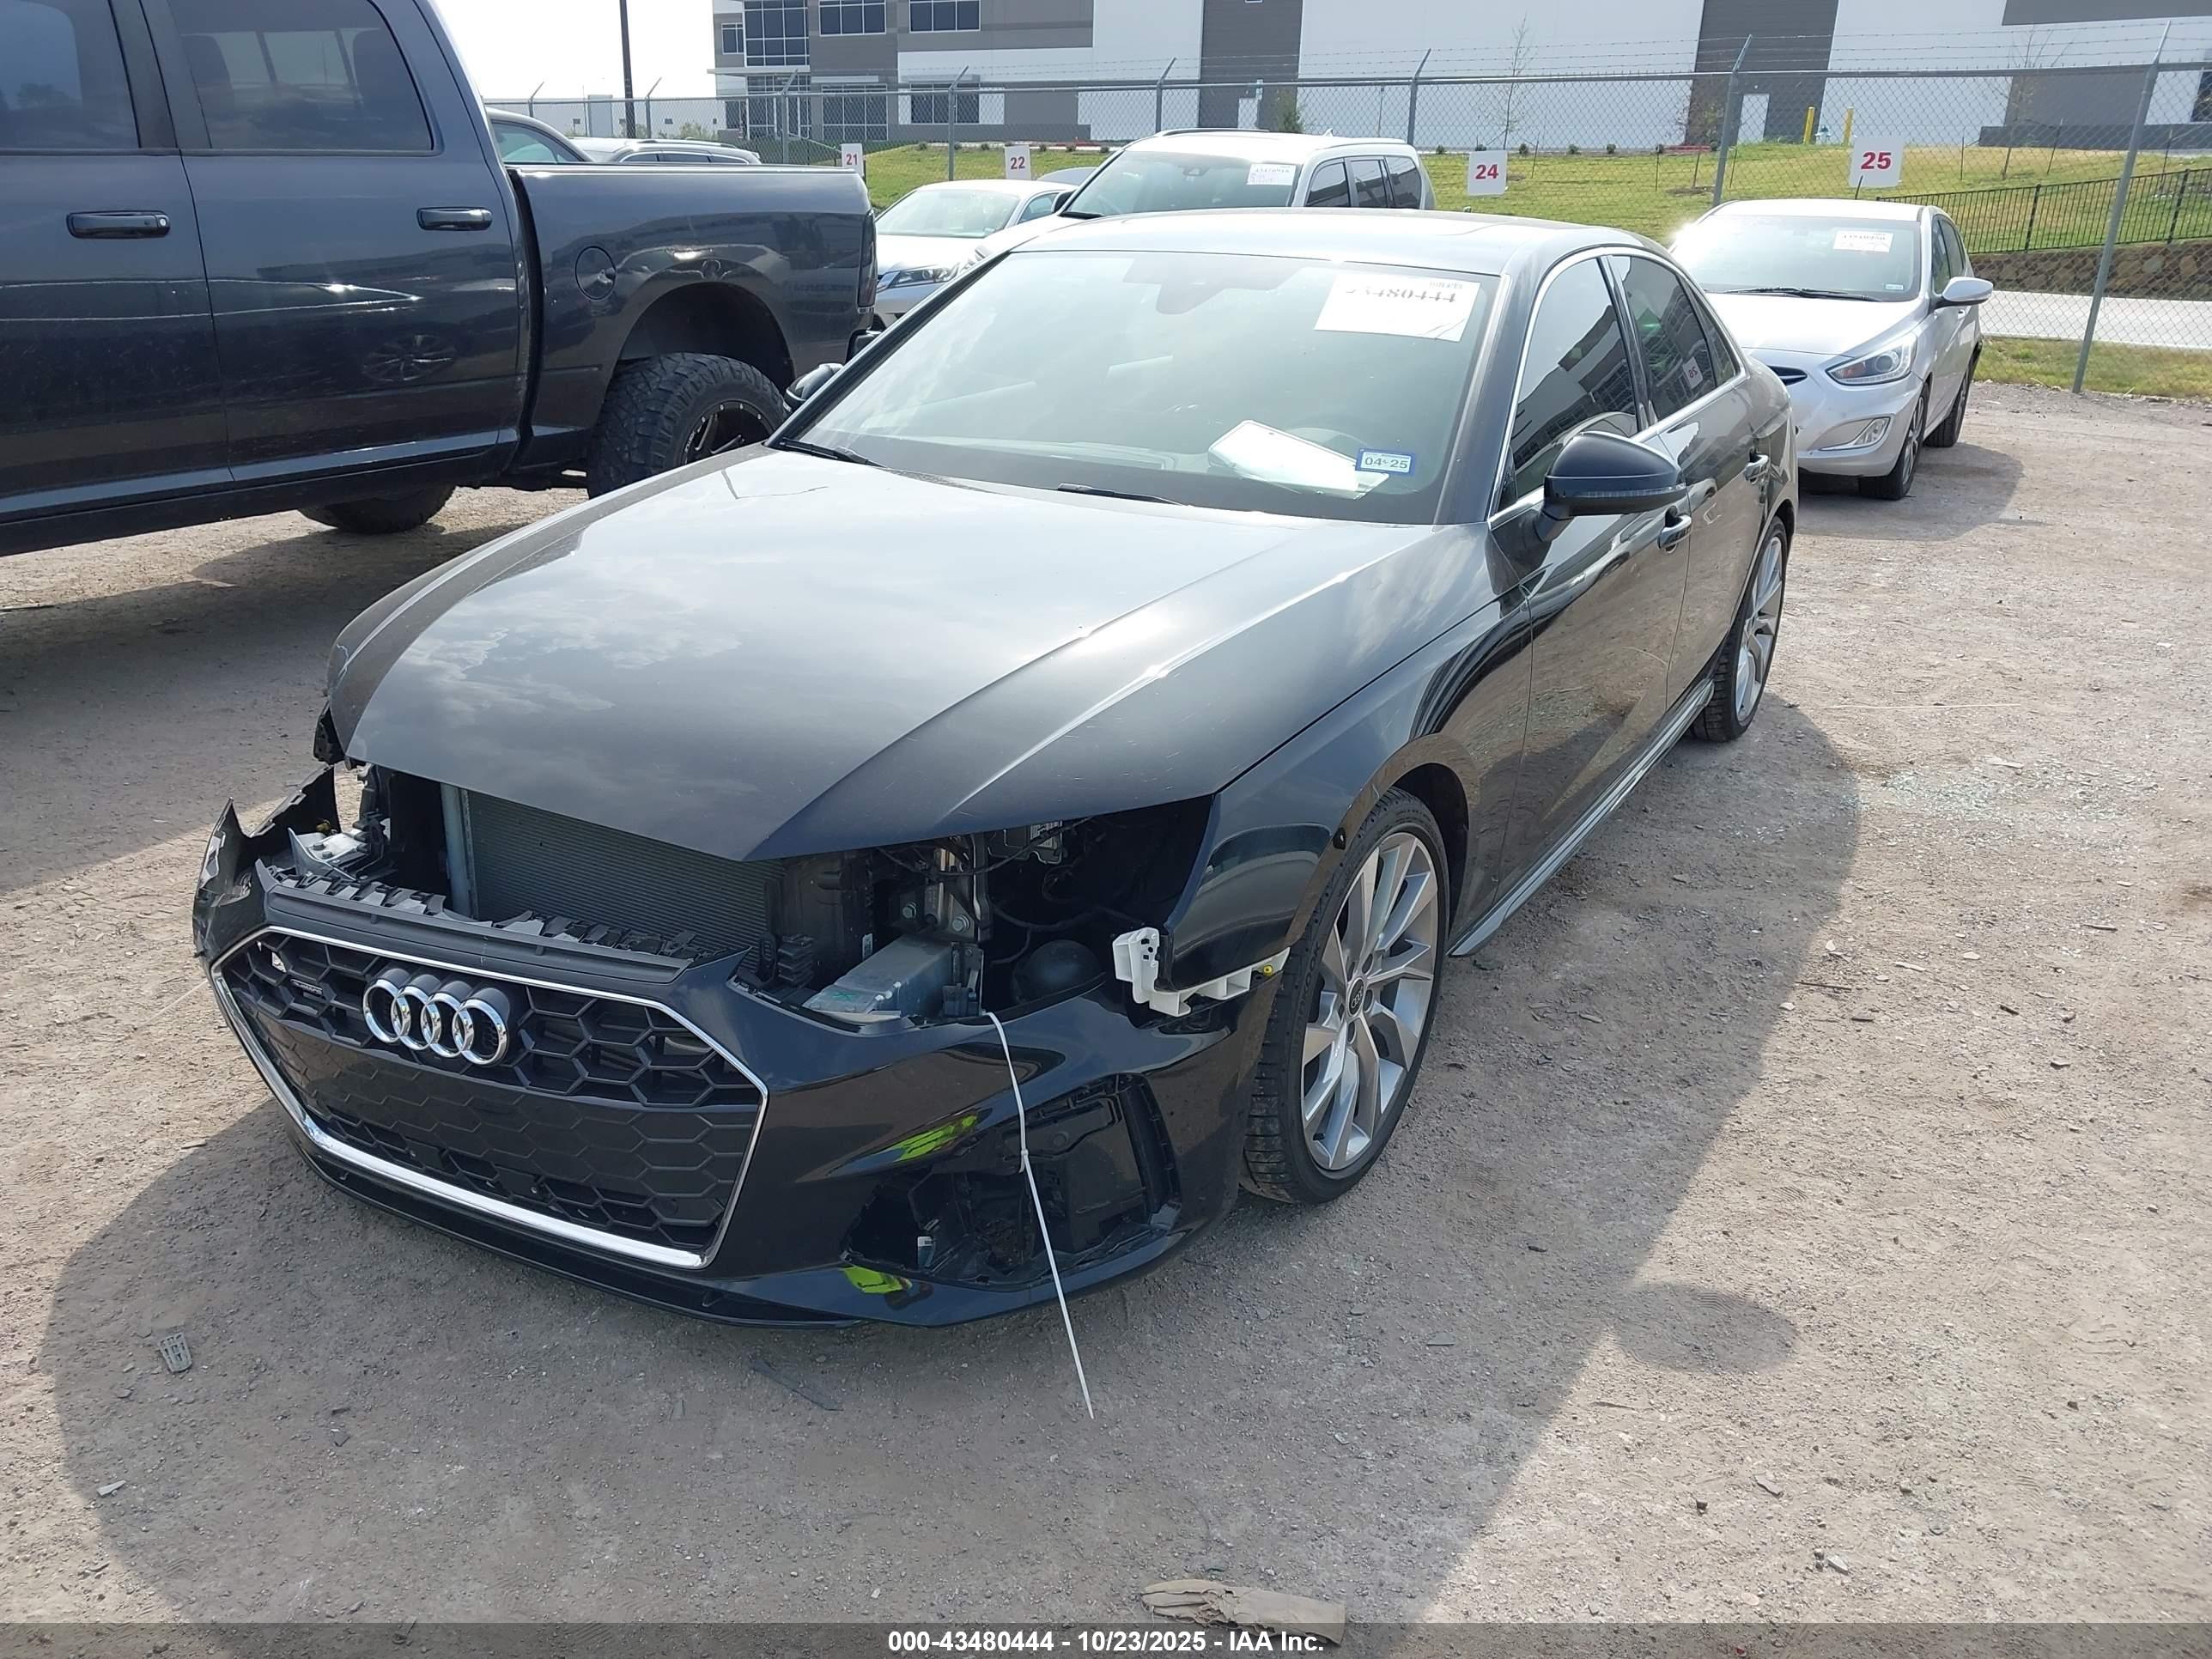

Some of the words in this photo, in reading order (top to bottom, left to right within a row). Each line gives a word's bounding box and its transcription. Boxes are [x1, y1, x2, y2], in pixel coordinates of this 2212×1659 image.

[846, 154, 858, 166] 21
[1010, 156, 1026, 170] 22
[1861, 152, 1892, 169] 25
[1475, 164, 1499, 179] 24
[1344, 288, 1457, 303] 480444
